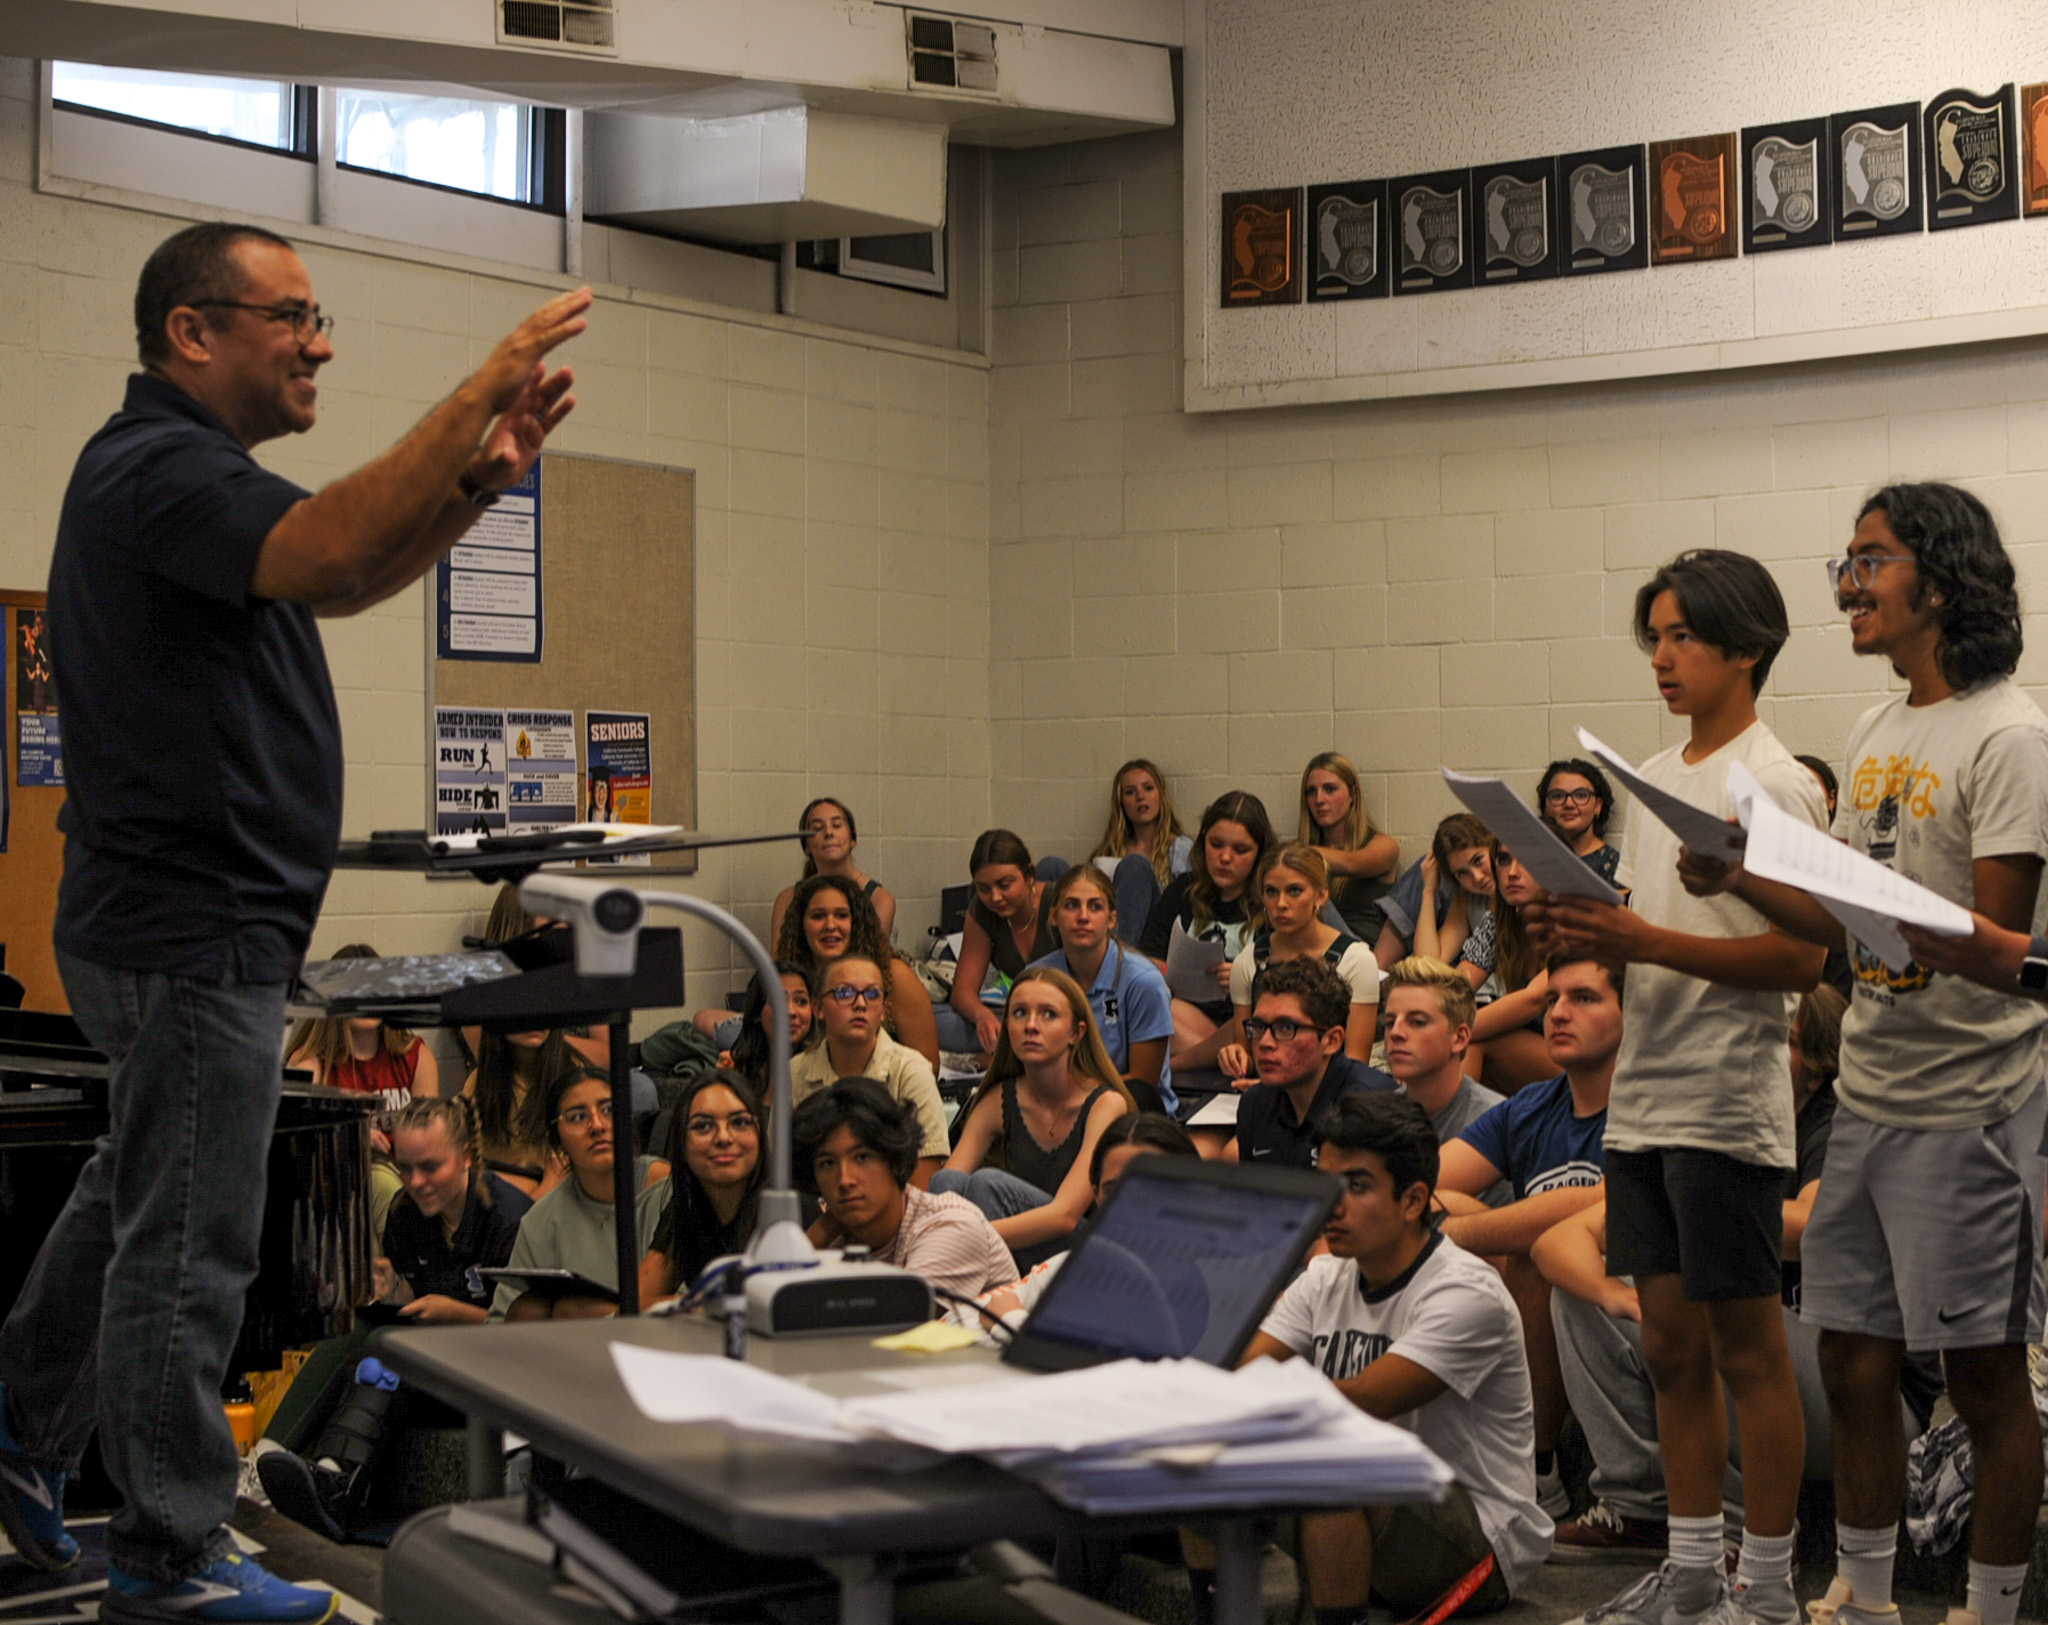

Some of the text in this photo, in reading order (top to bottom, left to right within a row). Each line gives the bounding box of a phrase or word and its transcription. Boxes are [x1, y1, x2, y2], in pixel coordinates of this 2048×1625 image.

[437, 712, 504, 727] ARMED INTRUDER
[507, 713, 573, 727] CRISIS RESPONSE
[440, 727, 502, 740] HOW TO RESPOND
[591, 721, 646, 742] SENIORS
[440, 747, 475, 763] RUN
[438, 788, 473, 803] HIDE
